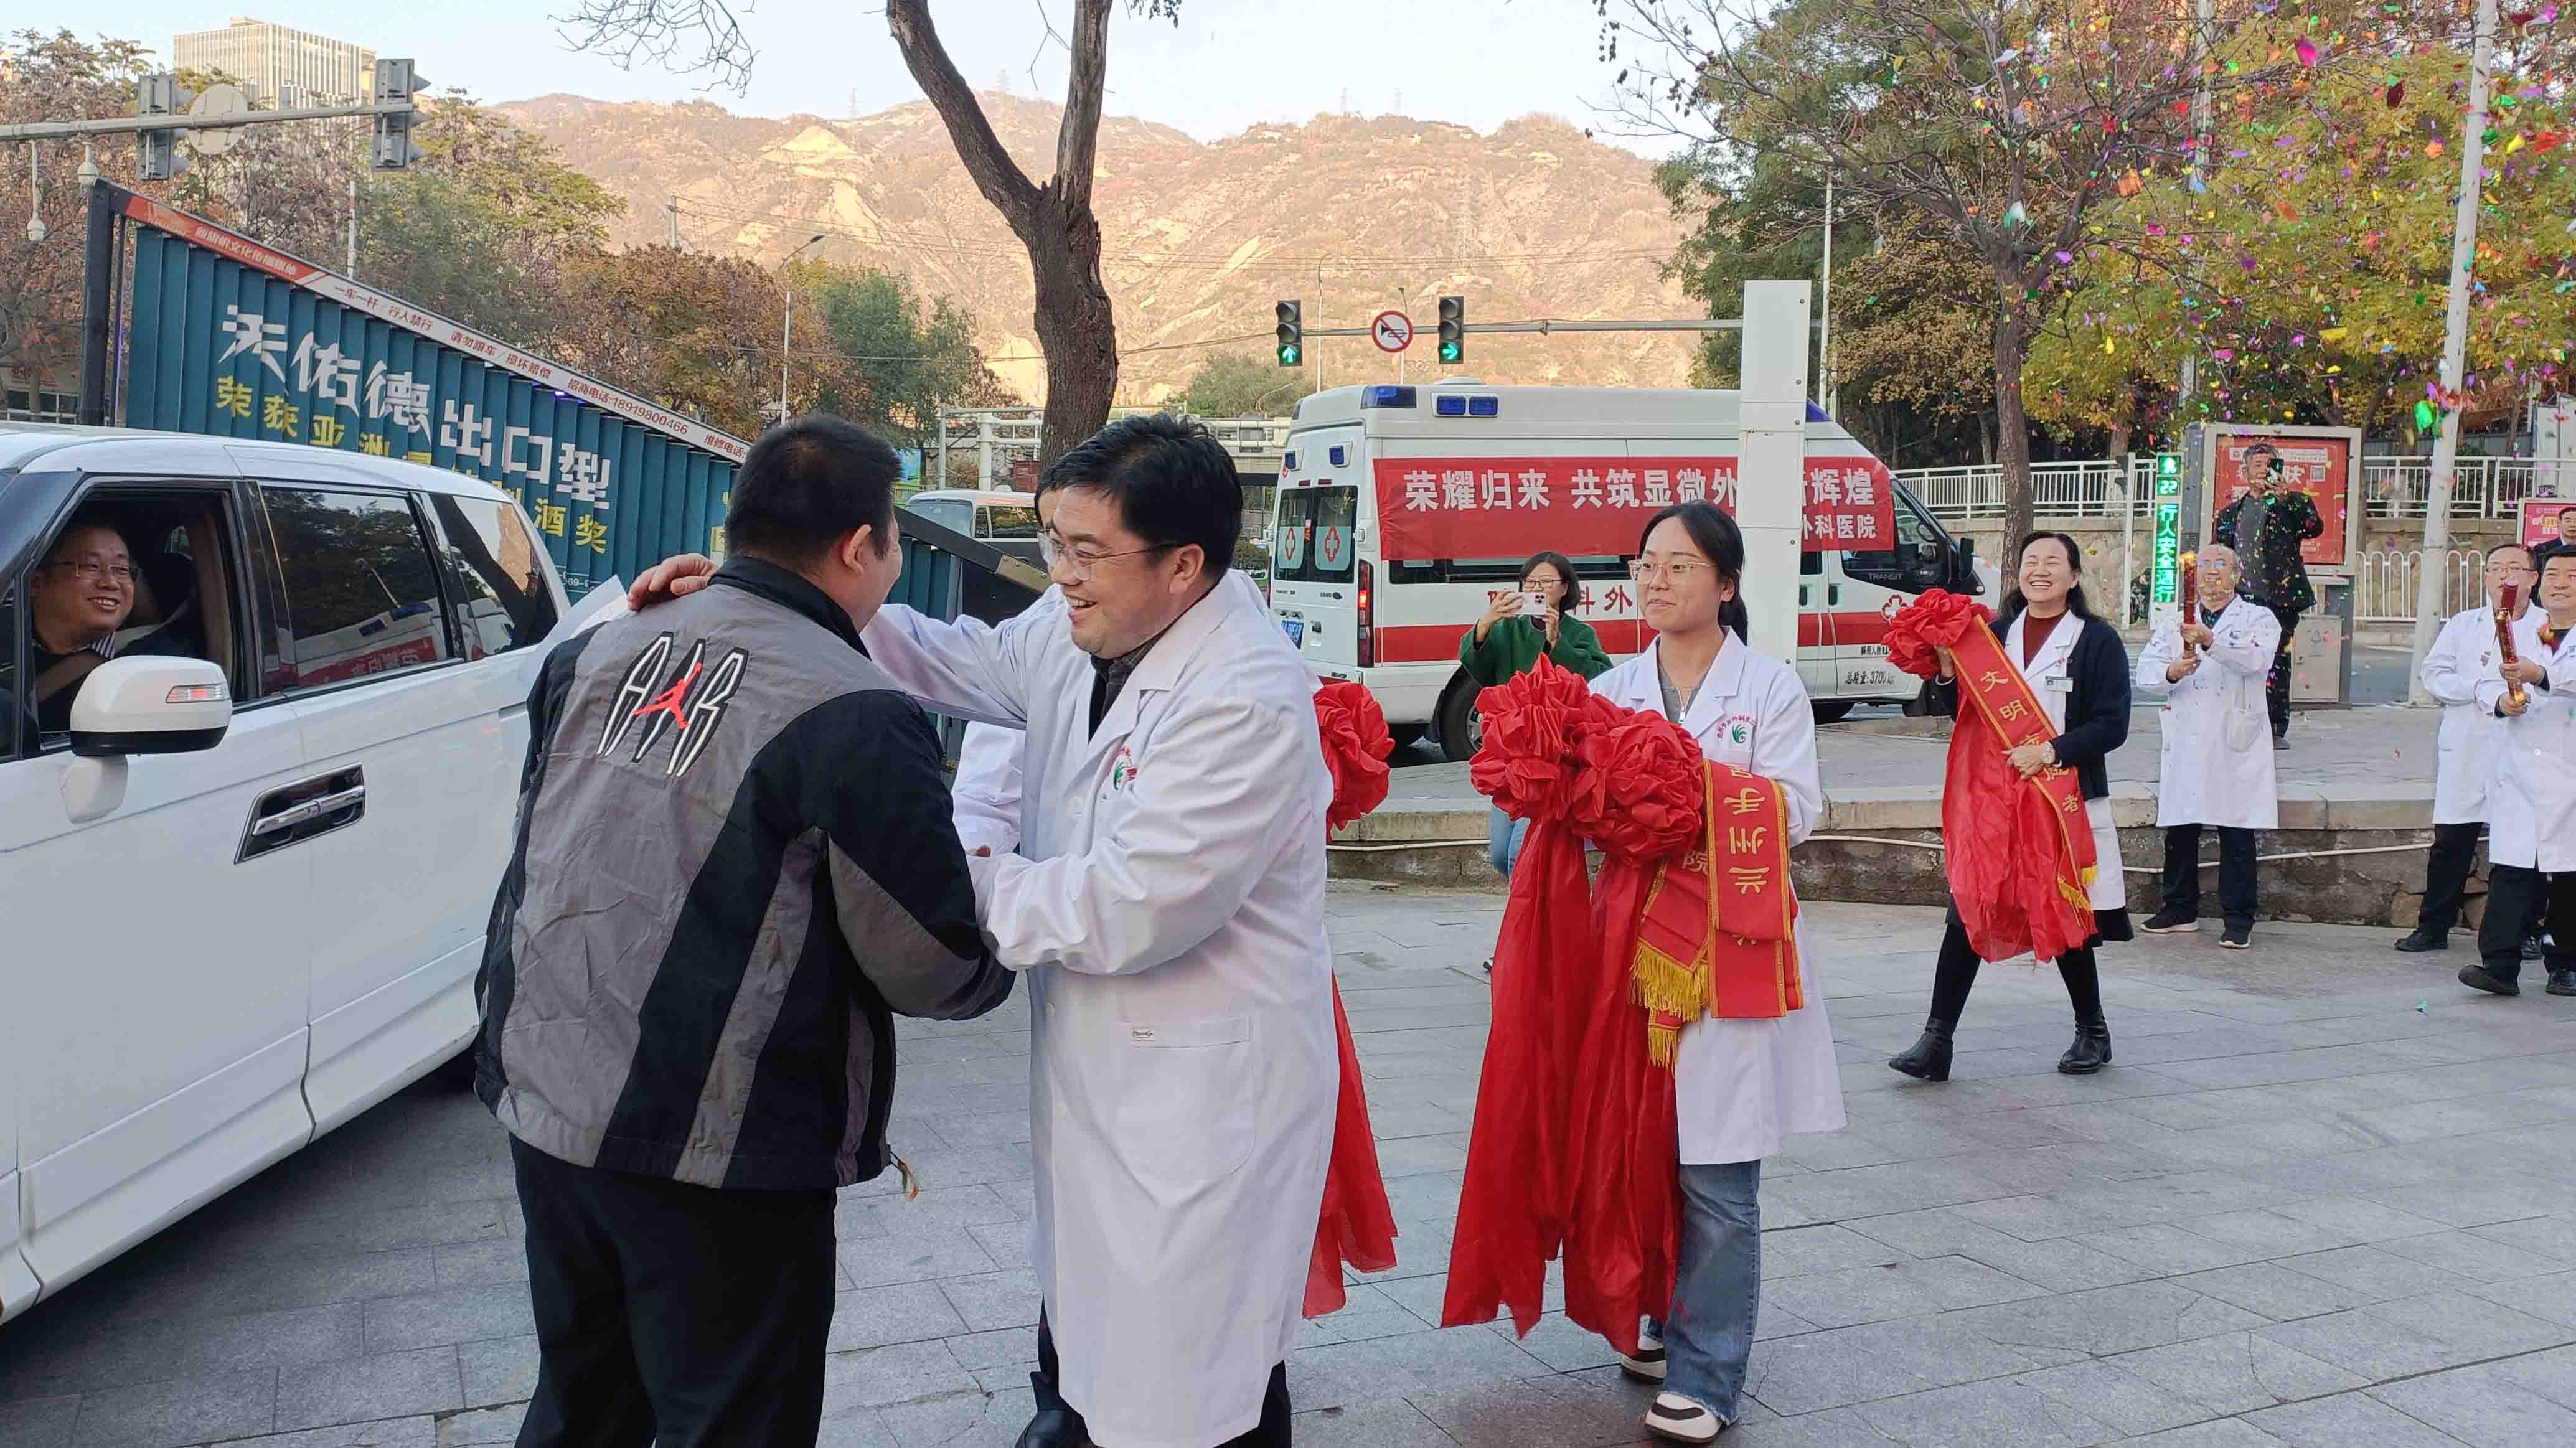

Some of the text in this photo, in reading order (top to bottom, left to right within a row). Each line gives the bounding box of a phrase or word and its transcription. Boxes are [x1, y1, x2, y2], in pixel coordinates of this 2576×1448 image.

[1403, 468, 1551, 512] 荣耀归来
[2158, 479, 2178, 494] 22
[2156, 504, 2178, 603] 行人安全通行
